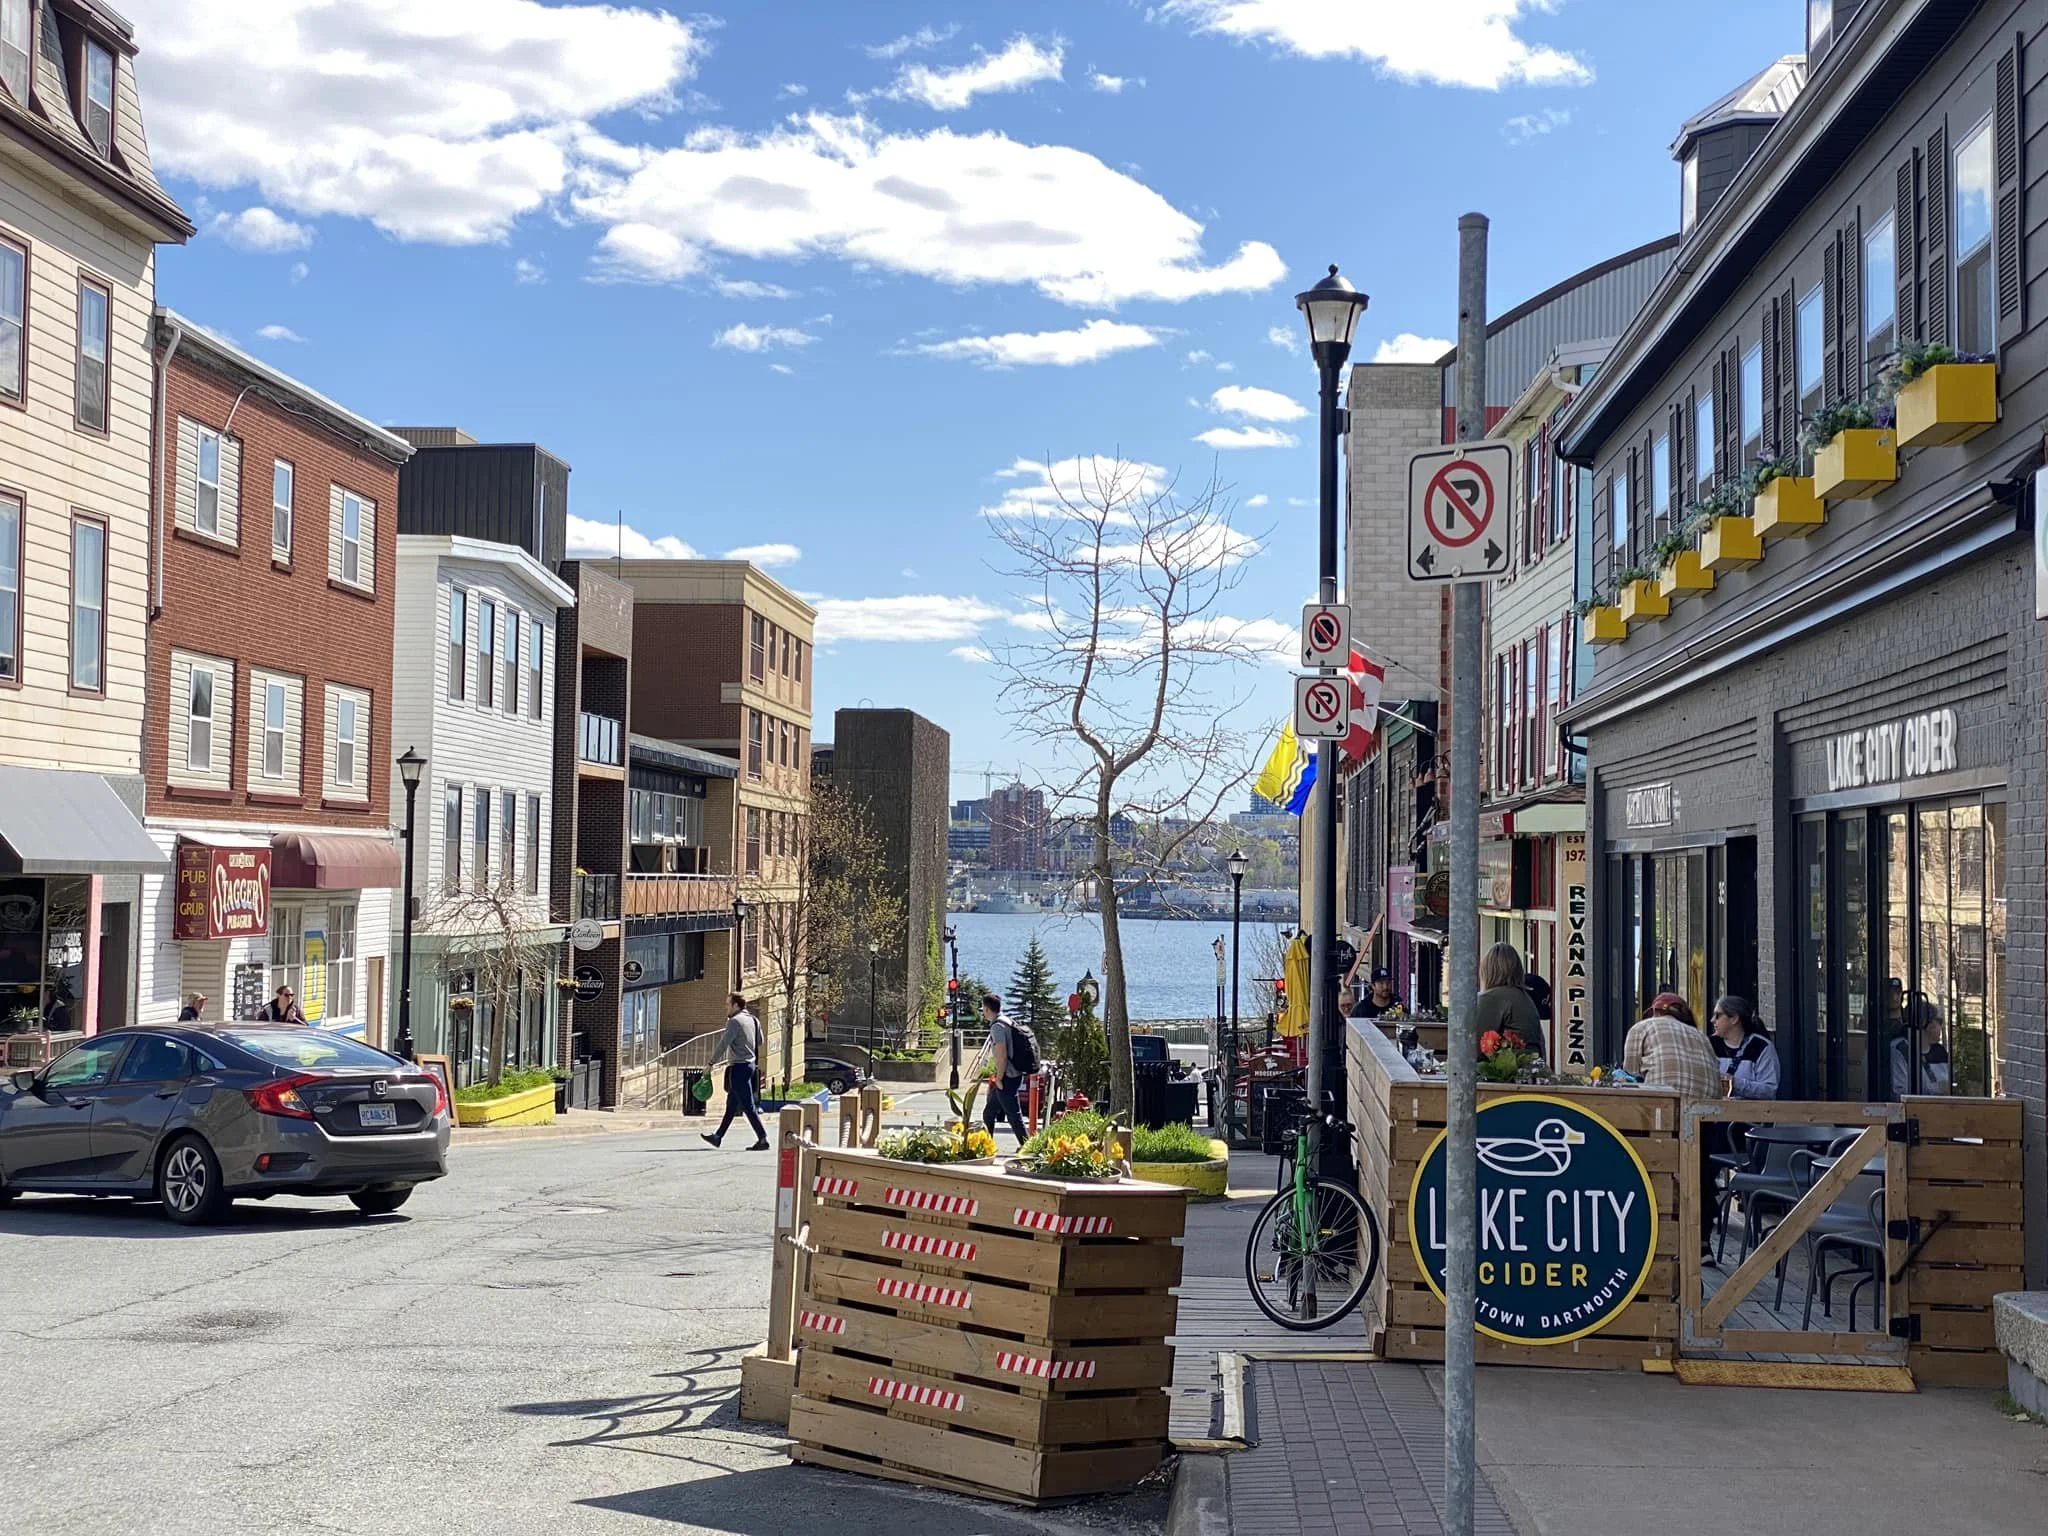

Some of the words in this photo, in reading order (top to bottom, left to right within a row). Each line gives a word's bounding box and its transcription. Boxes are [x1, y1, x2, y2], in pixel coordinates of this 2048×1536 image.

[1826, 731, 1865, 791] LAKE
[1865, 722, 1902, 784] CITY
[1905, 708, 1958, 776] CIDER
[181, 870, 207, 884] PUB
[1566, 850, 1586, 861] 197
[180, 902, 205, 916] GRUB
[212, 863, 269, 933] STAGGERS
[1567, 885, 1586, 977] REVANA
[1567, 987, 1586, 1065] PIZZA
[1429, 1187, 1528, 1252] LKE
[1546, 1189, 1635, 1253] CITY
[1479, 1261, 1588, 1287] CIDER
[1541, 1267, 1629, 1329] DARTMOUTH
